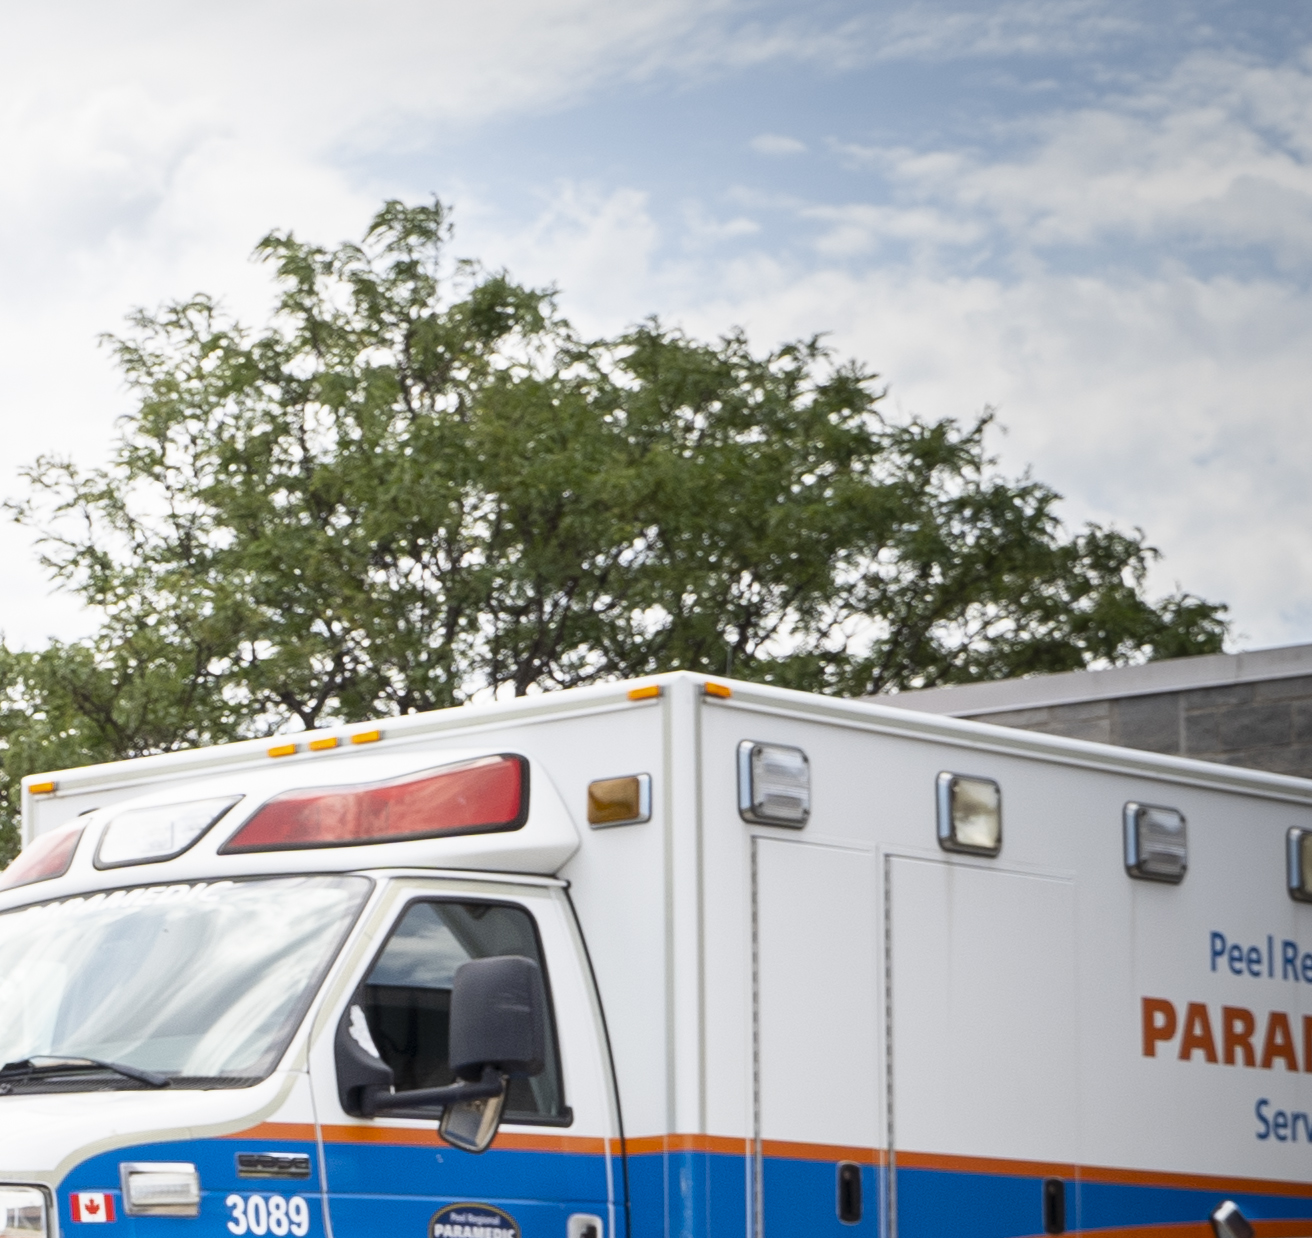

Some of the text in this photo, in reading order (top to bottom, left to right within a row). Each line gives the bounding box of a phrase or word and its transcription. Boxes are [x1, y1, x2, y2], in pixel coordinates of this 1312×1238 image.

[1210, 930, 1275, 980] Peel
[1141, 996, 1312, 1075] PARA
[225, 1194, 309, 1236] 3089
